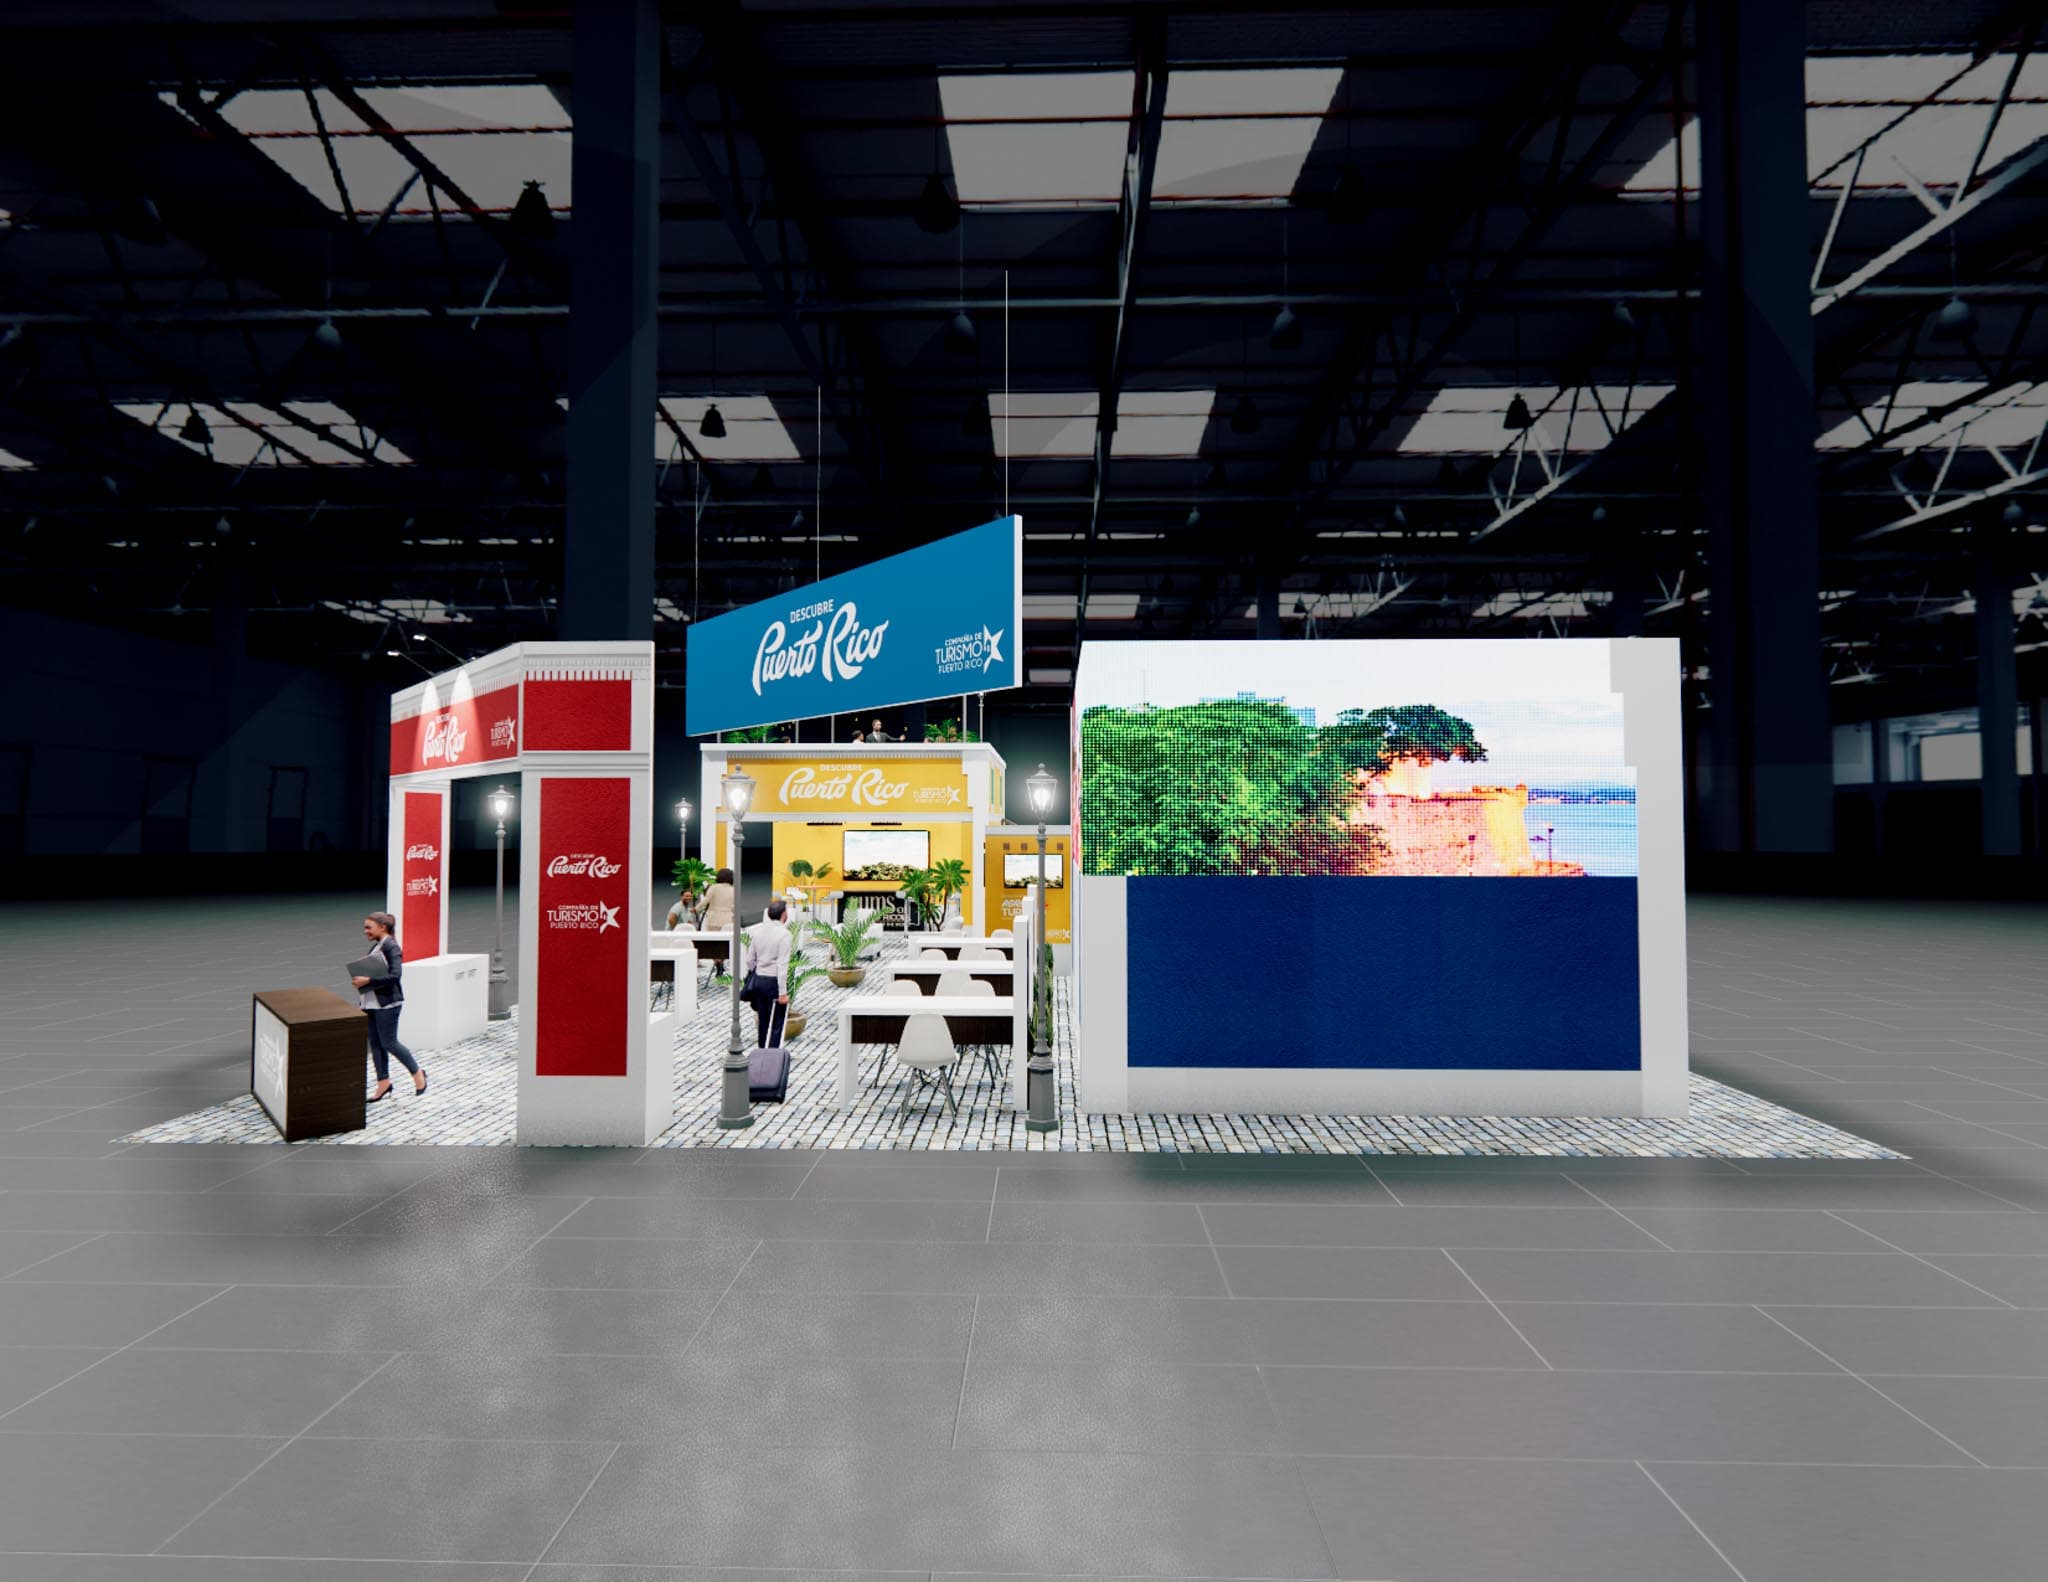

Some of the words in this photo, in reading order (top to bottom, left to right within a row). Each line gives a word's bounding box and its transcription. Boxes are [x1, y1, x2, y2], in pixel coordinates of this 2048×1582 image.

[790, 599, 834, 623] DESCUBRE
[752, 620, 823, 696] Puerto
[822, 601, 889, 681] Rico
[934, 640, 983, 665] TURISMO
[938, 662, 963, 674] PUERTO
[964, 658, 983, 669] RICO
[779, 767, 853, 806] Puerto
[851, 768, 910, 806] Rico
[547, 855, 590, 878] Puerto
[588, 856, 622, 878] Rico
[546, 910, 599, 922] TURISMO
